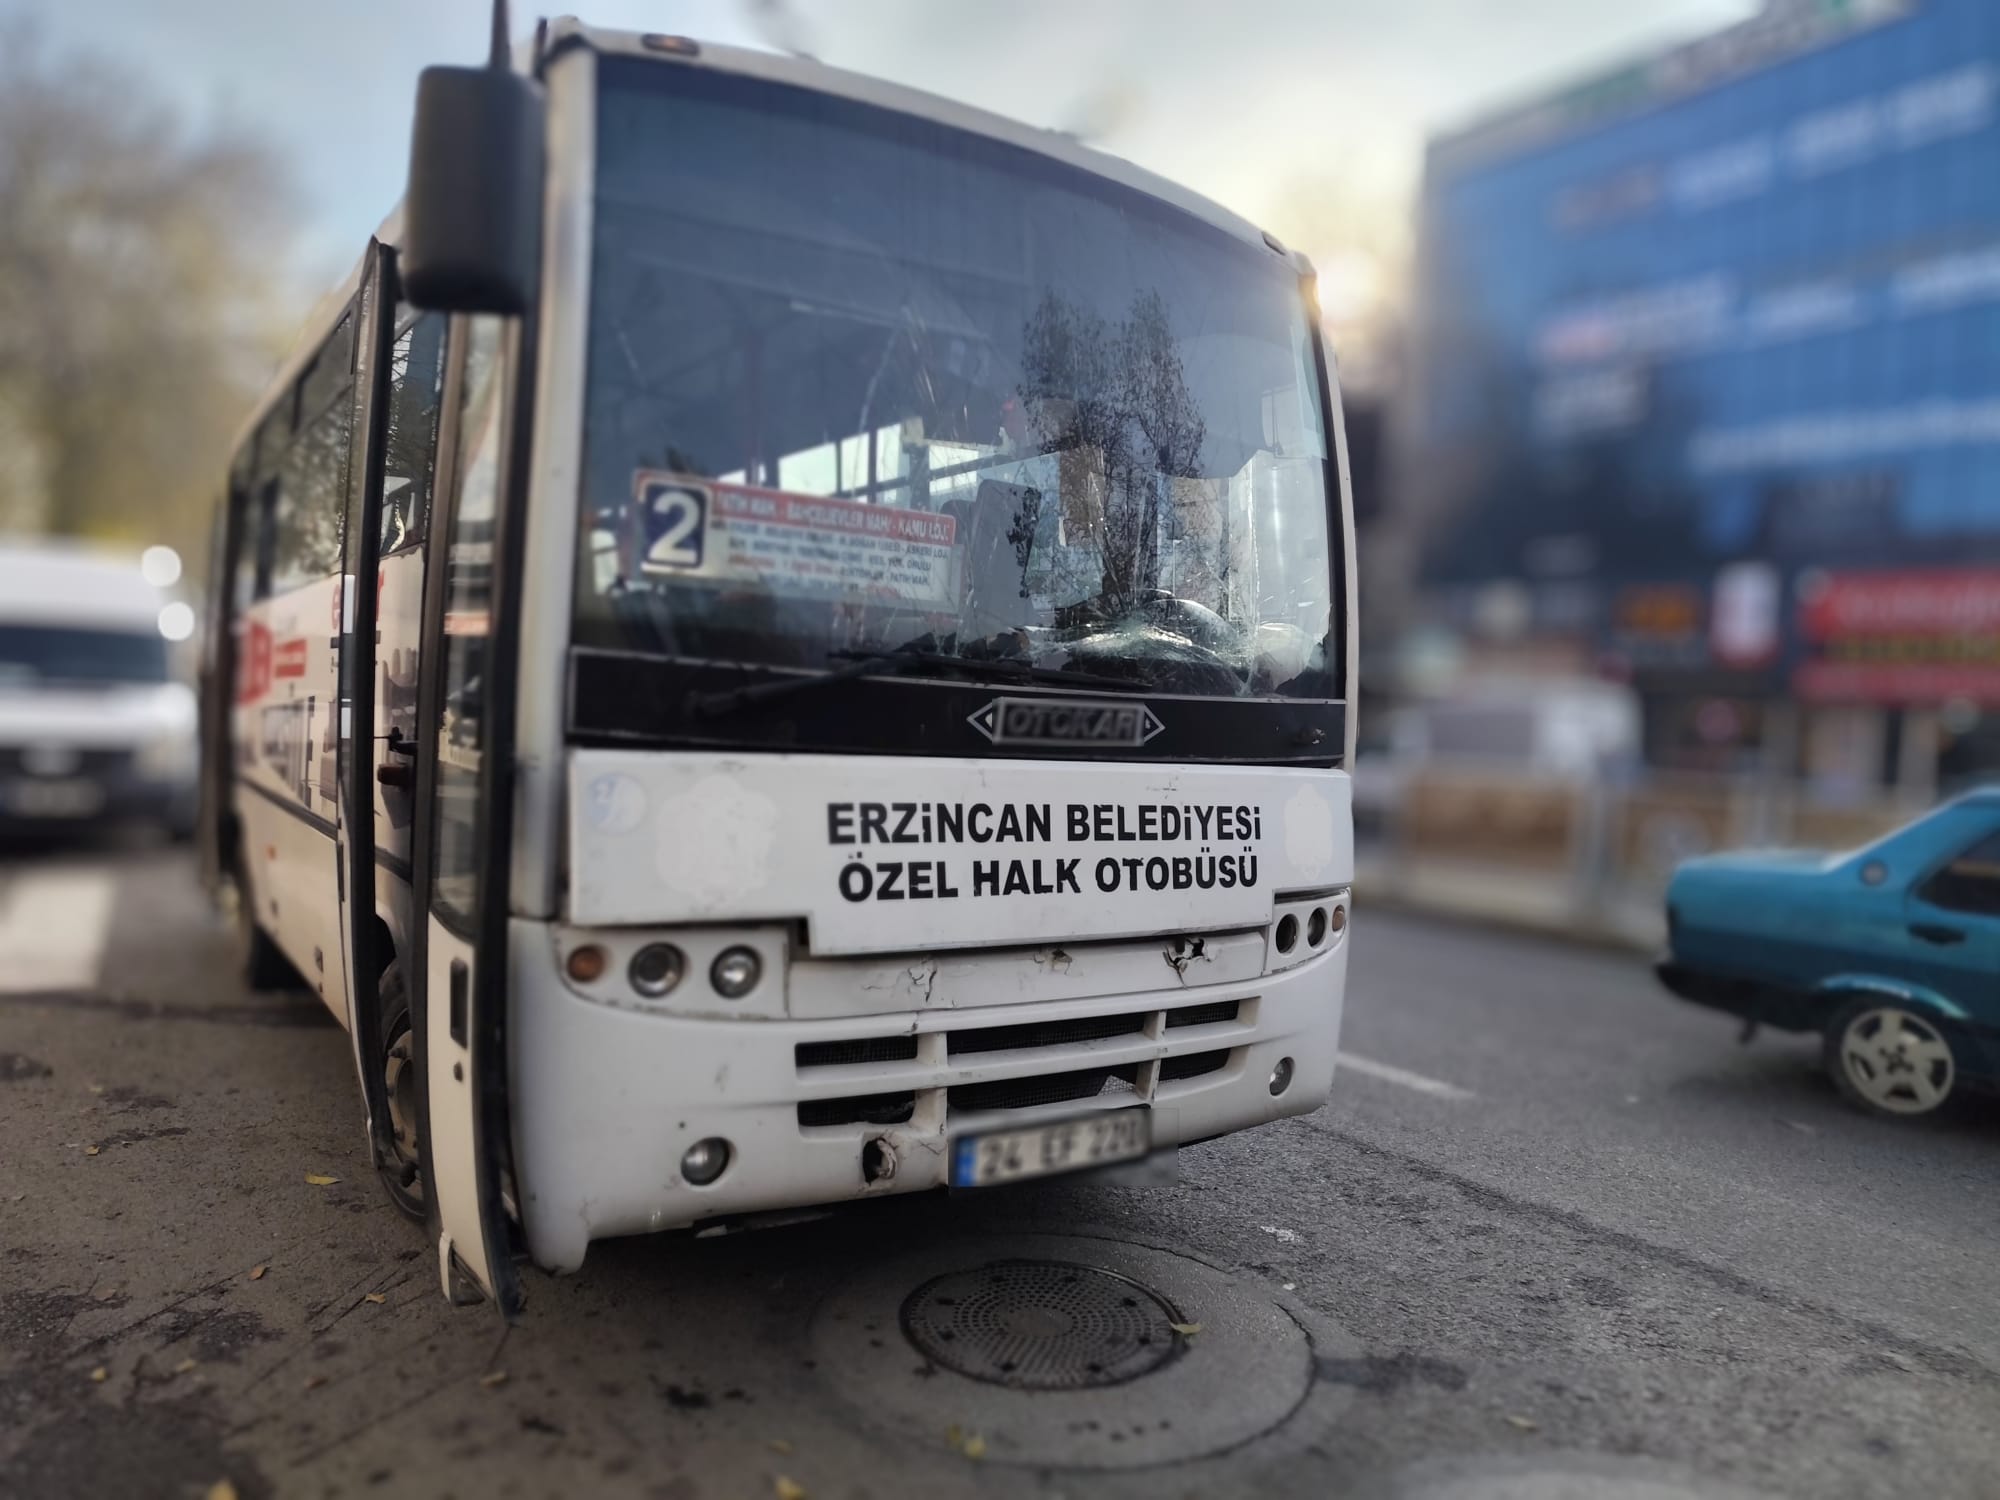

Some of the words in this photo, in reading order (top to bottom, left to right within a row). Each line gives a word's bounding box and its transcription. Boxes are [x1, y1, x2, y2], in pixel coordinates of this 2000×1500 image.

[649, 491, 699, 564] 2
[838, 851, 958, 903] ÖZEL
[973, 858, 1081, 897] HALK
[1095, 846, 1257, 893] OTOBÜSÜ
